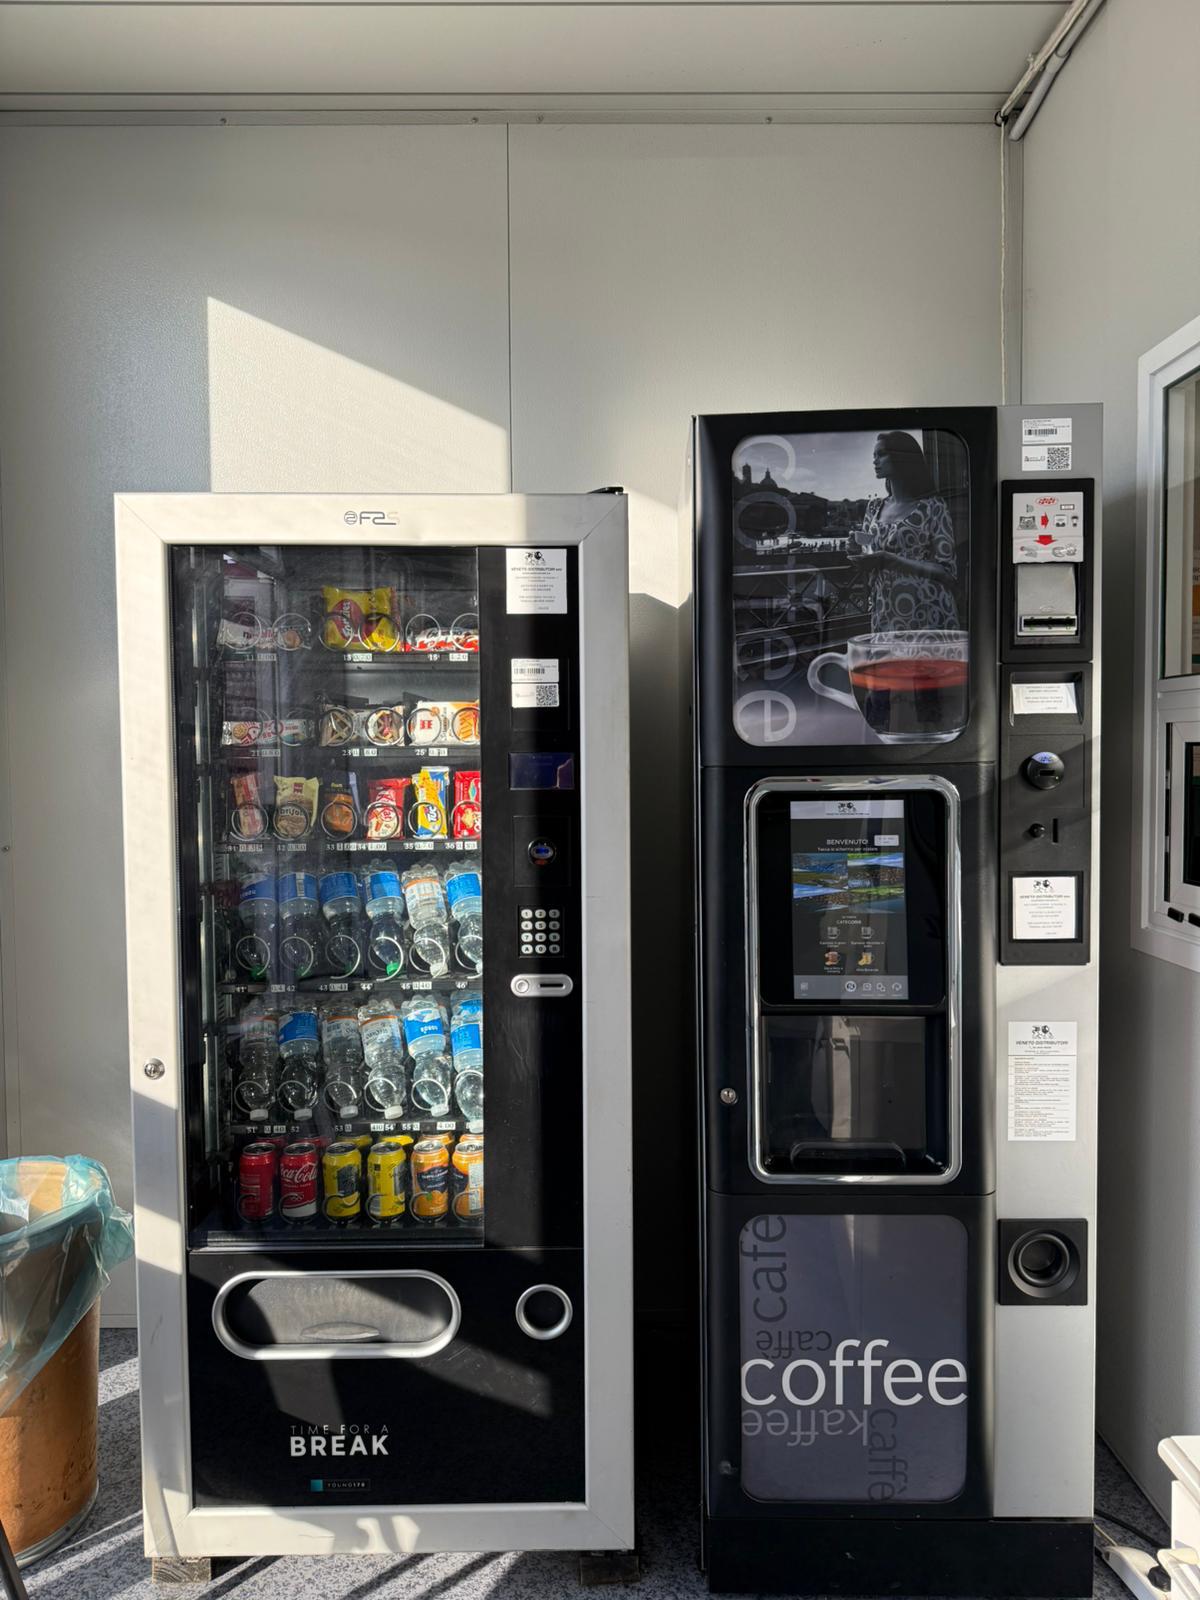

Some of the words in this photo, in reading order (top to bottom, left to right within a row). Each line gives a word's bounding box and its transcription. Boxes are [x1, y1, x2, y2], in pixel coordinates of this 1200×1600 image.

[741, 1339, 968, 1406] coffee
[290, 1425, 329, 1435] TIME
[340, 1424, 369, 1435] FOR
[381, 1424, 389, 1434] A
[742, 1409, 868, 1447] kaffee
[290, 1435, 389, 1456] BREAK
